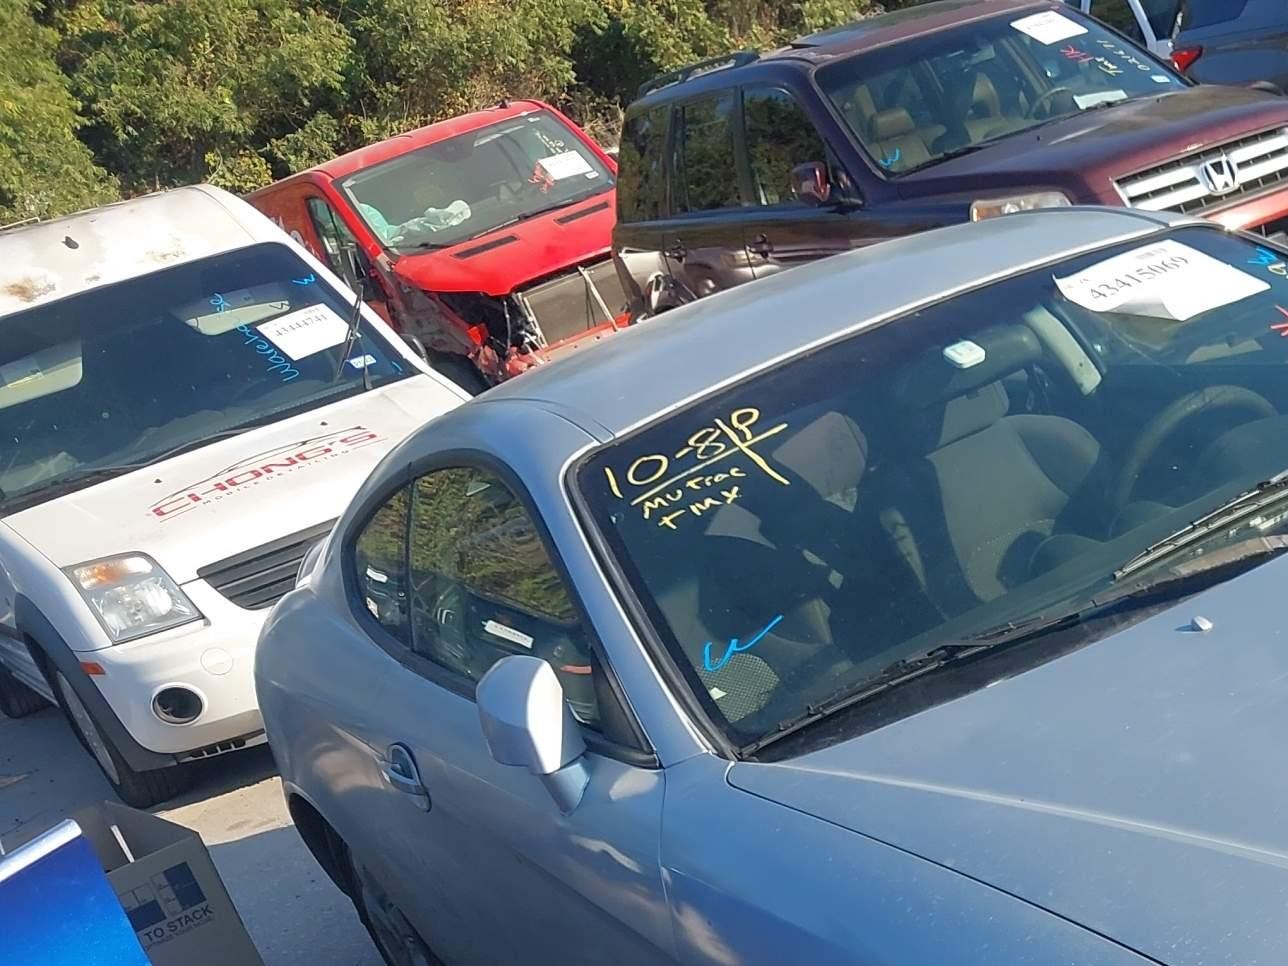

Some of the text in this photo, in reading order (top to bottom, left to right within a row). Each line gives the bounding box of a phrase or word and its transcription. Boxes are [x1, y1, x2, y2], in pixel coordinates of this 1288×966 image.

[1090, 256, 1190, 300] 43415069
[209, 292, 300, 382] Warehose
[152, 430, 378, 517] CHONG'S
[143, 927, 166, 942] TO
[166, 904, 214, 933] STACK
